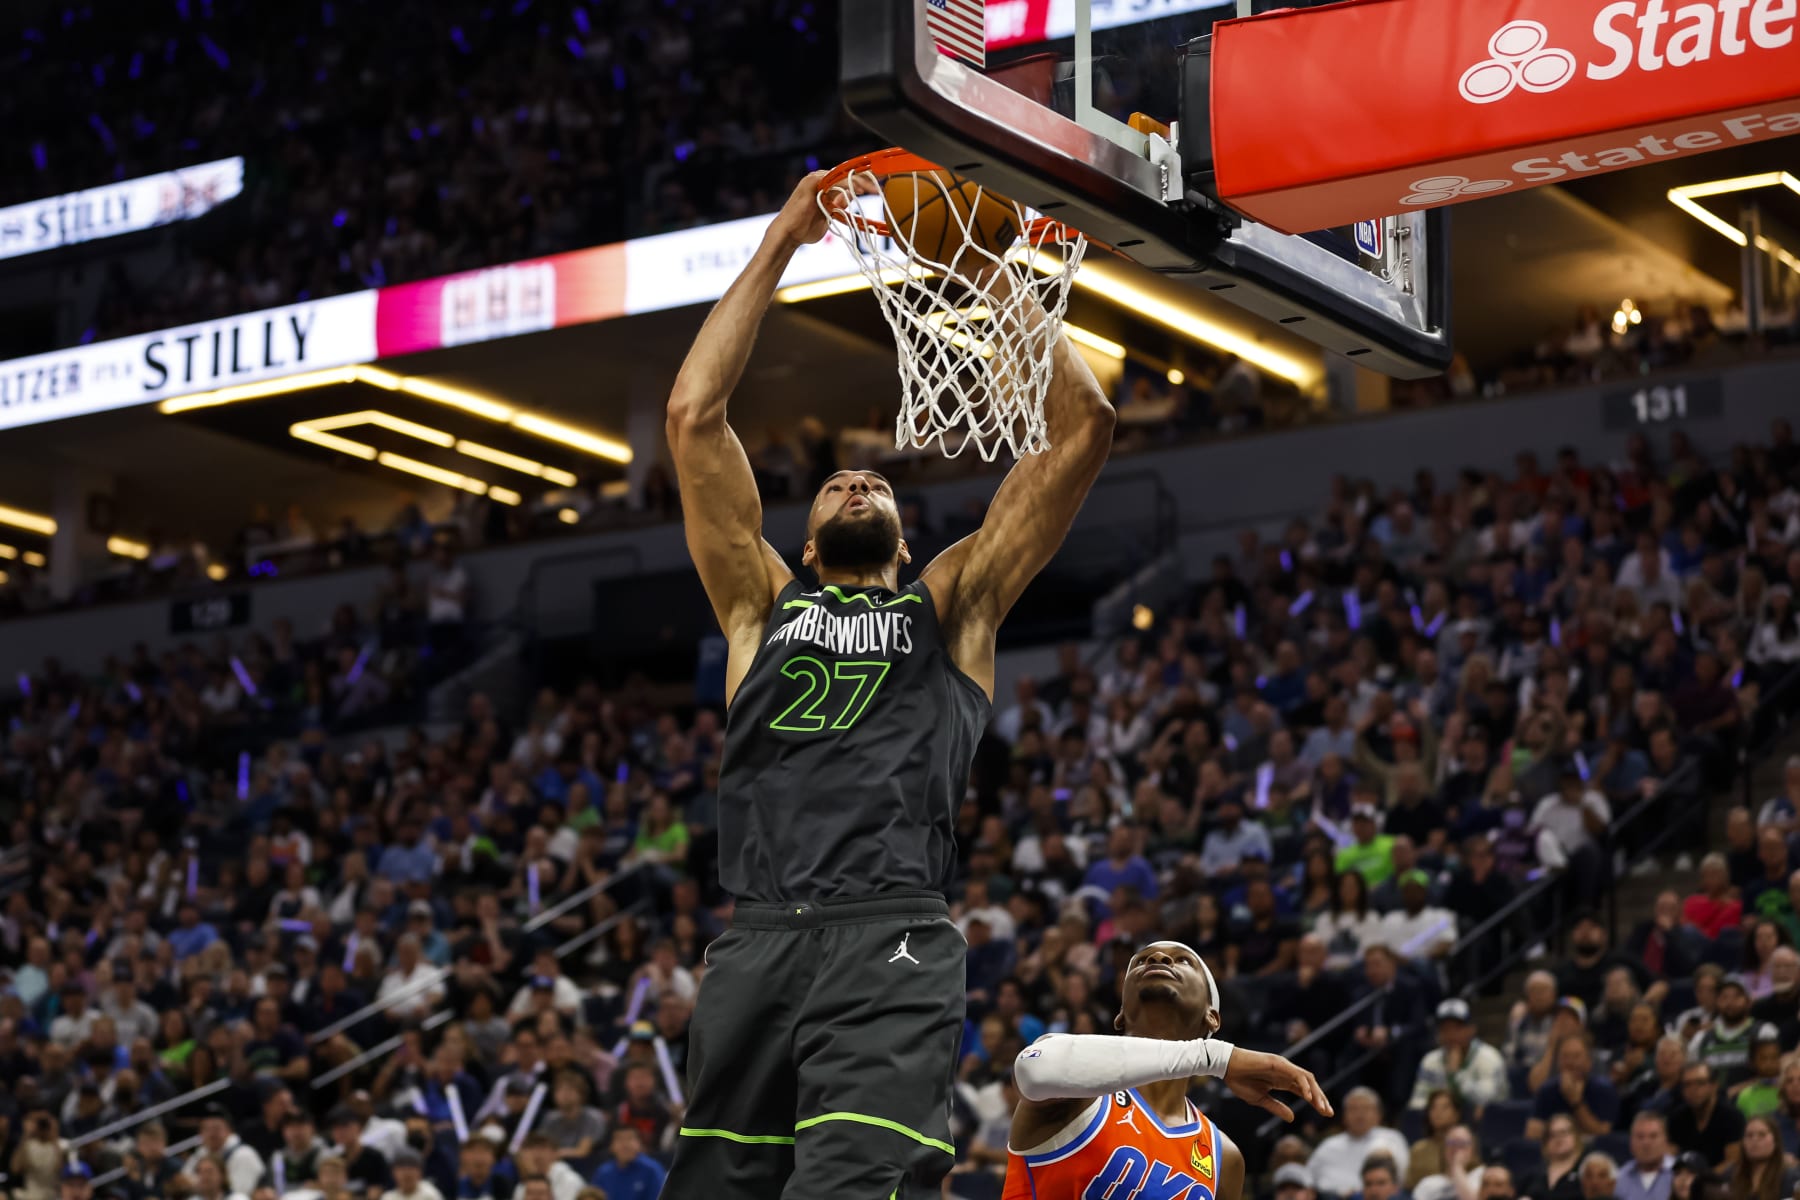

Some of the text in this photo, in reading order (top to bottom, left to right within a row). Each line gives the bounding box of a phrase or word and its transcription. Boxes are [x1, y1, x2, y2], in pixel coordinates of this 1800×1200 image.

[1586, 0, 1798, 81] State
[1511, 130, 1722, 182] State
[36, 192, 131, 243] STILLY
[1358, 221, 1374, 247] NBA
[143, 312, 314, 390] STILLY
[1632, 384, 1686, 424] 131
[769, 655, 891, 732] 27
[1115, 1090, 1127, 1106] 6
[1081, 1145, 1216, 1200] OK
